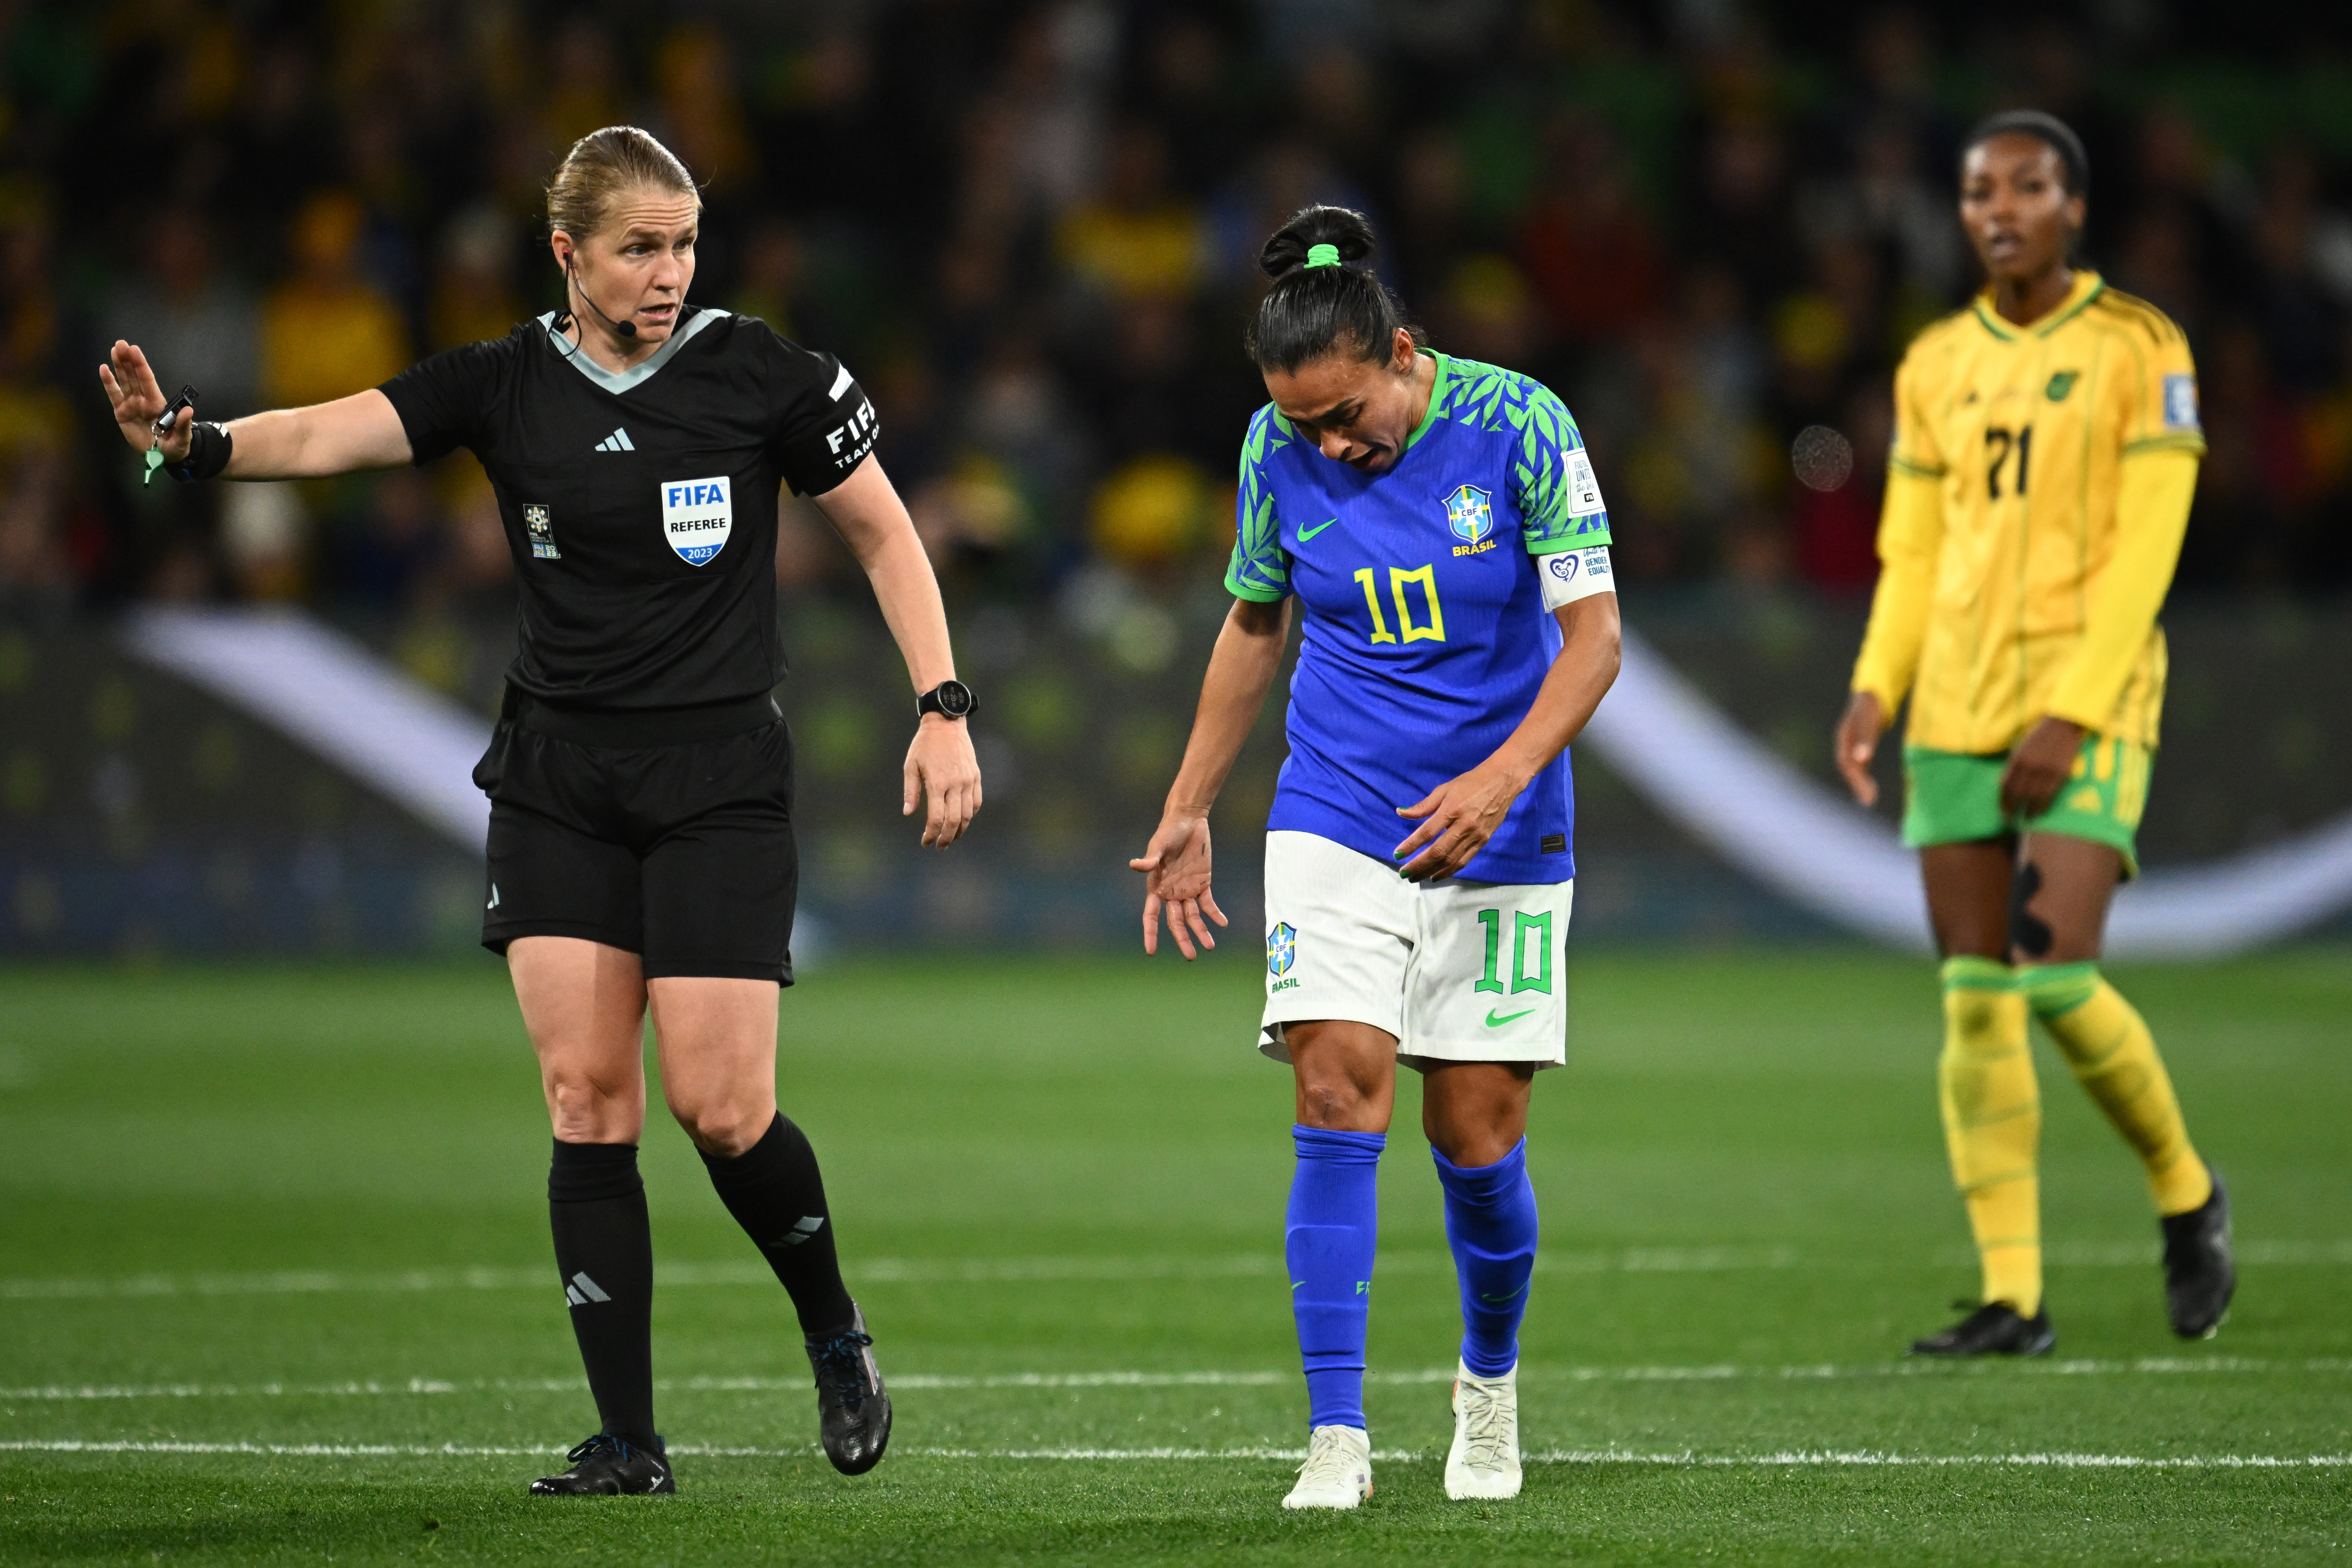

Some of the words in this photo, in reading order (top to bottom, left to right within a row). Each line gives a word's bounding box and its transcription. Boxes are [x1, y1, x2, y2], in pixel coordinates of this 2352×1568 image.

[835, 438, 872, 468] TEAM
[1576, 483, 1585, 493] the
[668, 484, 724, 508] FIFA
[1461, 508, 1477, 516] CBF
[671, 518, 726, 533] REFEREE
[688, 548, 712, 559] 2023
[1452, 539, 1497, 557] BRASIL
[1585, 556, 1607, 567] GENDER
[1588, 565, 1611, 576] EQUALITY
[1354, 563, 1446, 645] 10
[1276, 944, 1286, 952] CBF
[1475, 909, 1552, 995] 10
[1272, 978, 1300, 994] BRASIL
